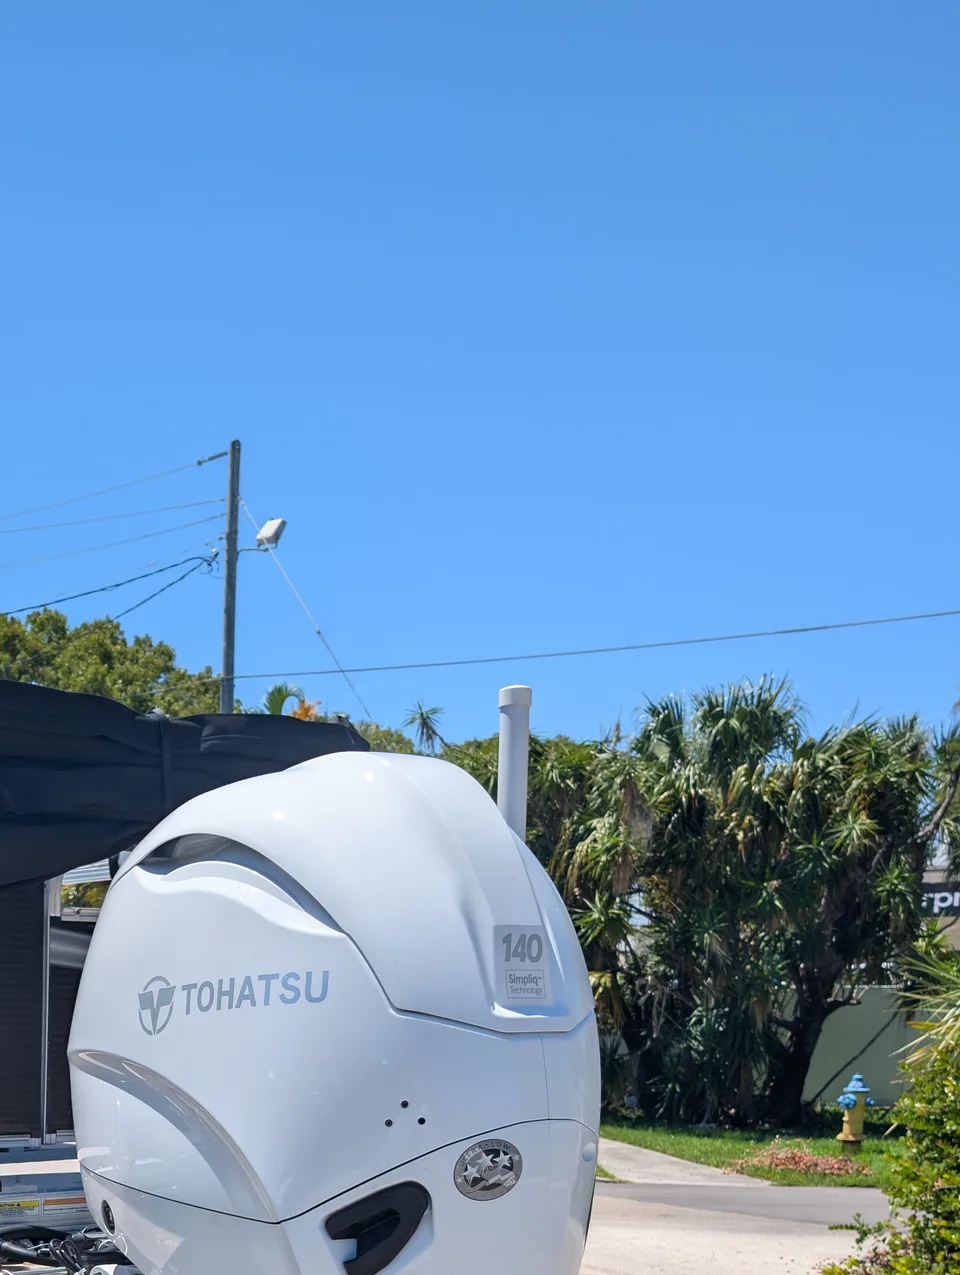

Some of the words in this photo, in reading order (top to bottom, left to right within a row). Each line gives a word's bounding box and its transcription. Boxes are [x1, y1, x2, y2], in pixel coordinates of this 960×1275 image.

[502, 933, 543, 963] 140
[181, 970, 330, 1015] TOHATSU
[510, 986, 543, 996] Technology
[490, 1141, 511, 1150] LOW
